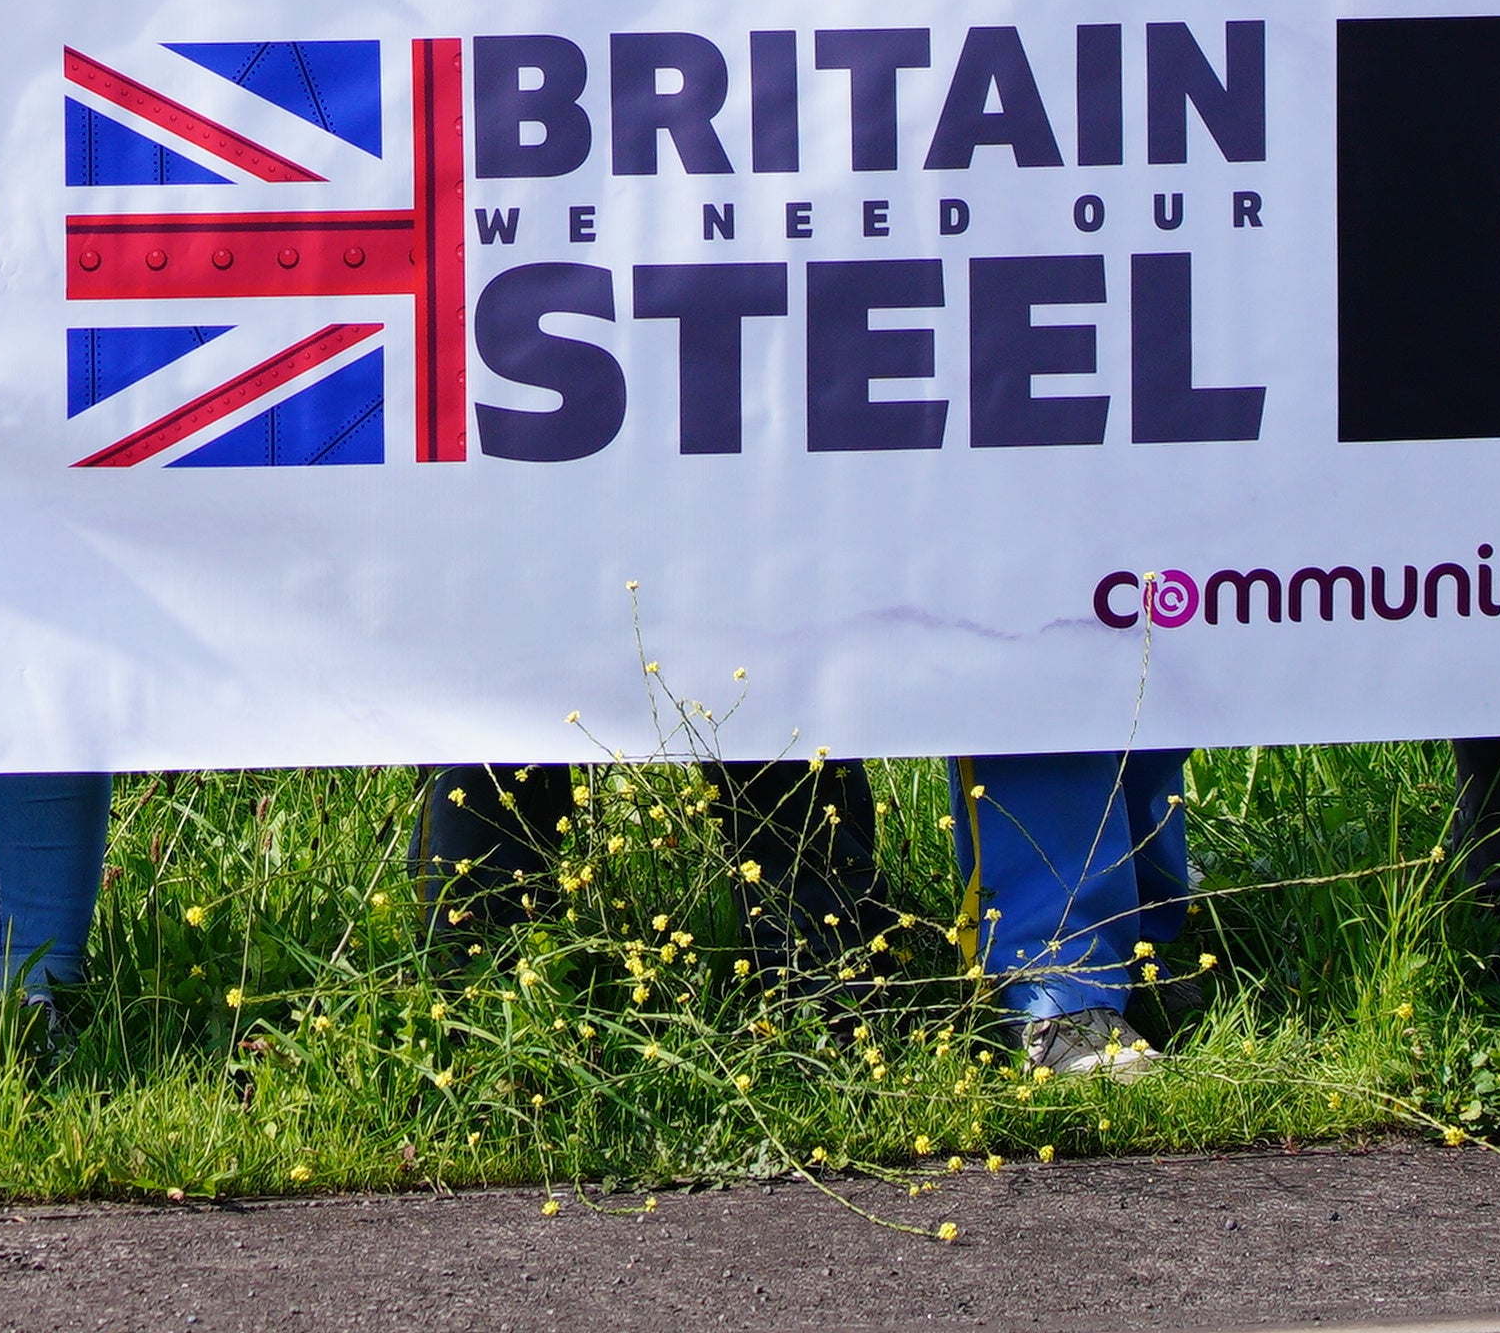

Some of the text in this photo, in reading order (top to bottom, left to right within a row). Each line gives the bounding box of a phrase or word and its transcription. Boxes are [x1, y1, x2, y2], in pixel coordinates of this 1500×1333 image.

[474, 20, 1267, 179] BRITAIN
[475, 191, 1264, 245] WE NEED OUR
[474, 252, 1268, 463] STEEL
